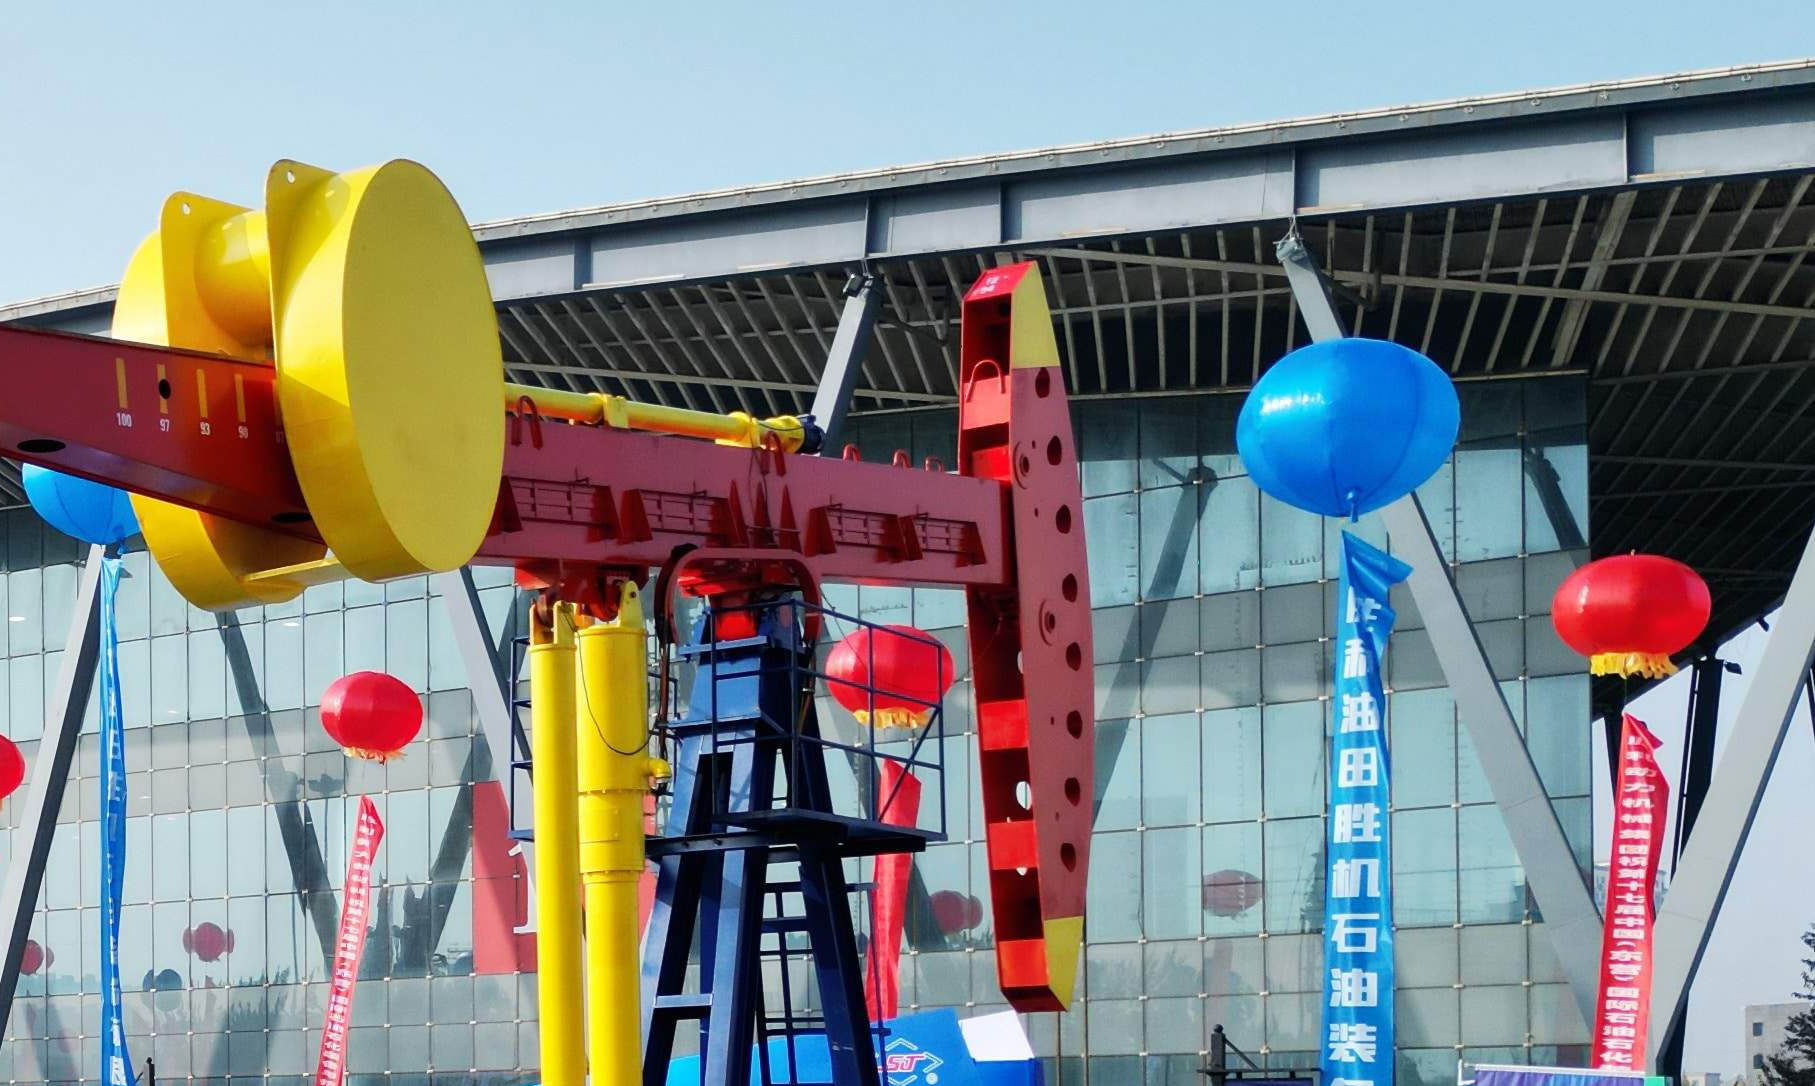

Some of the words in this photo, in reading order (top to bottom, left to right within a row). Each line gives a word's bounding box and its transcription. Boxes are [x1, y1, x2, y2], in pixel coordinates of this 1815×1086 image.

[116, 412, 133, 428] 100
[159, 418, 170, 432] 97
[200, 421, 211, 436] 93
